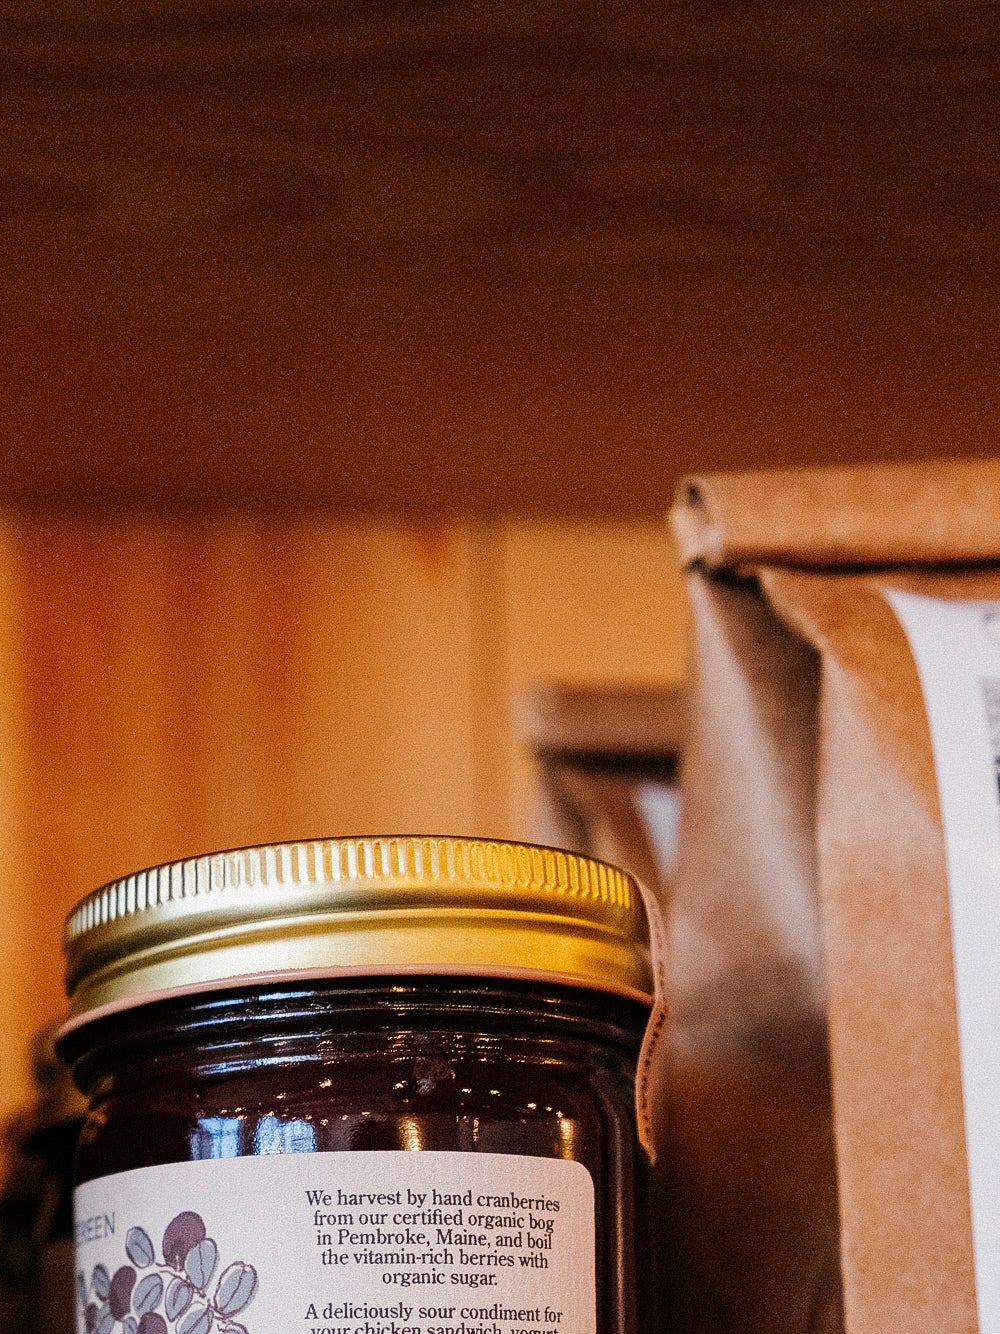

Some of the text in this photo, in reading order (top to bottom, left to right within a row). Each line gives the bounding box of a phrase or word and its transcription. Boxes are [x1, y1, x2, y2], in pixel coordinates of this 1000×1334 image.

[305, 1189, 560, 1213] We harvest by hand cranberries
[313, 1209, 555, 1234] from our certified organic bog
[316, 1229, 552, 1250] in Pembroke, Maine, and boil
[321, 1249, 549, 1269] the vitamin-rich berries with
[382, 1268, 498, 1288] organic sugar.
[304, 1302, 564, 1323] A deliciously sour condiment for
